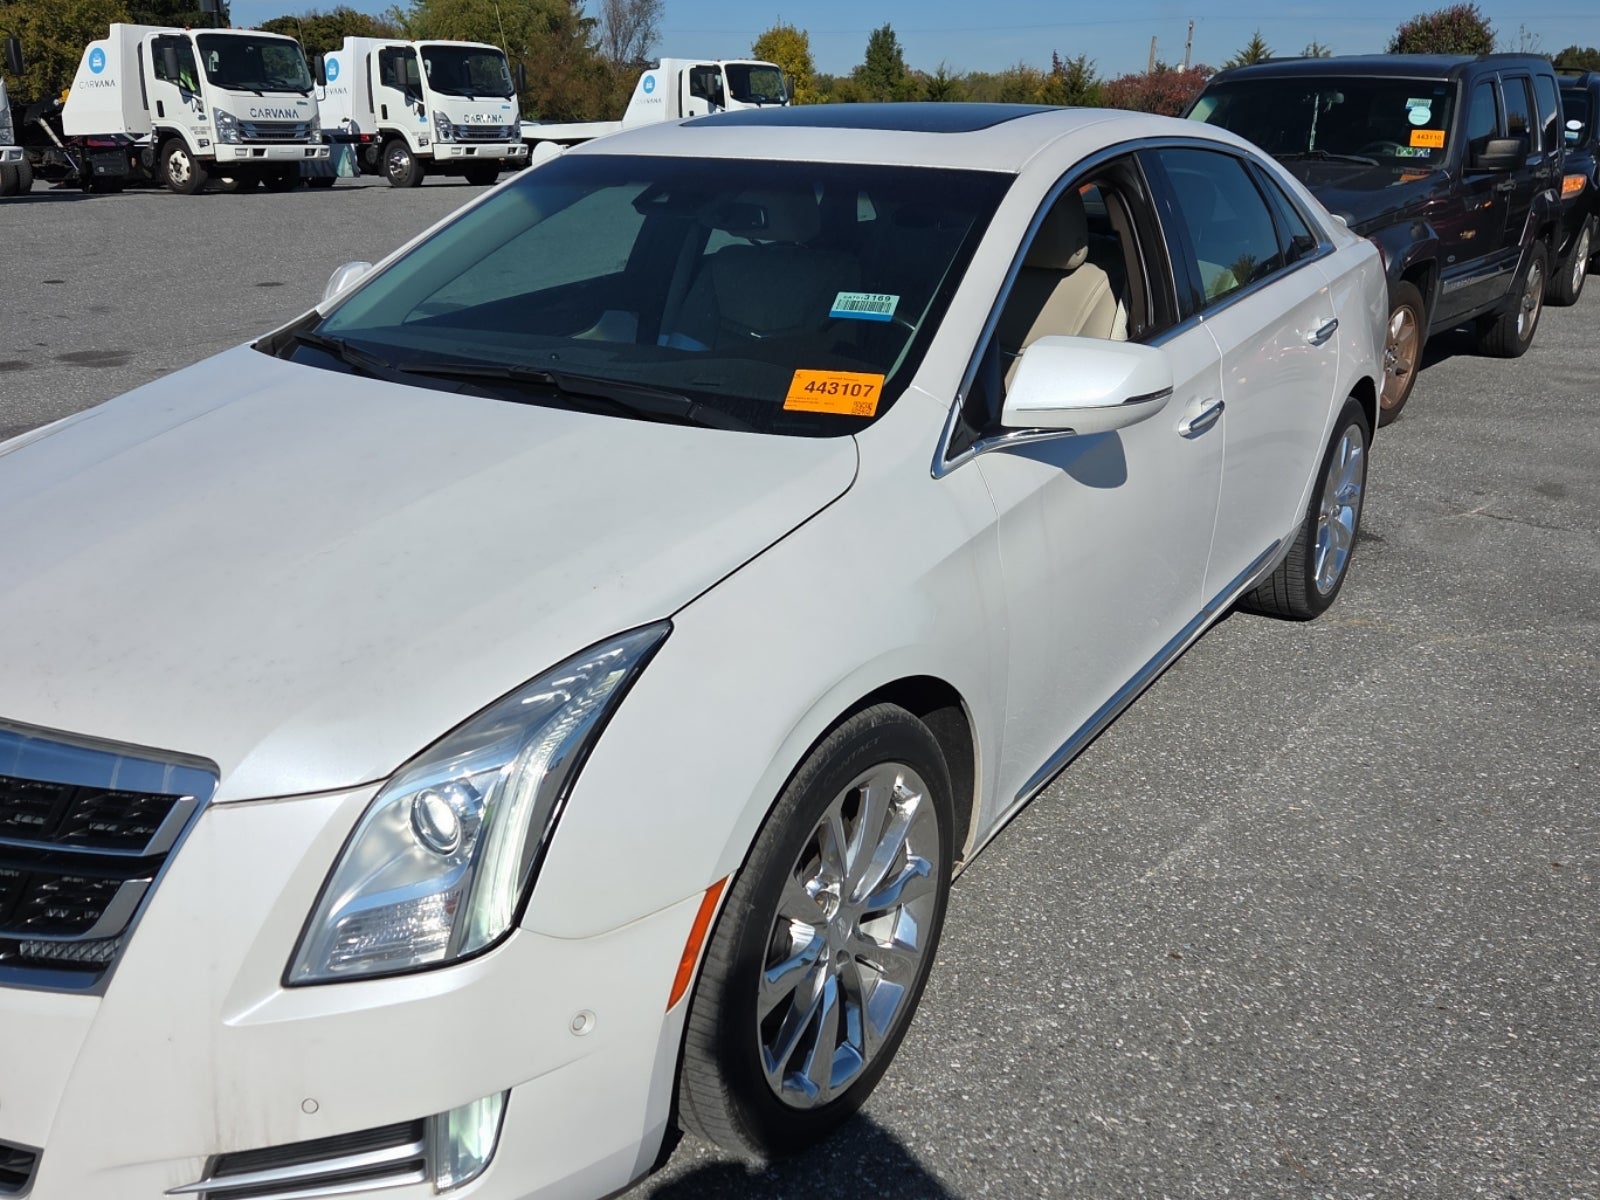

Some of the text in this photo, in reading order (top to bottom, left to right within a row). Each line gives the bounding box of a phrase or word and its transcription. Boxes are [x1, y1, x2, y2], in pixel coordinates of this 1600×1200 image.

[79, 80, 115, 89] CARVANA
[250, 108, 299, 119] CARVANA
[463, 114, 504, 123] CARVANA
[804, 380, 875, 397] 443107
